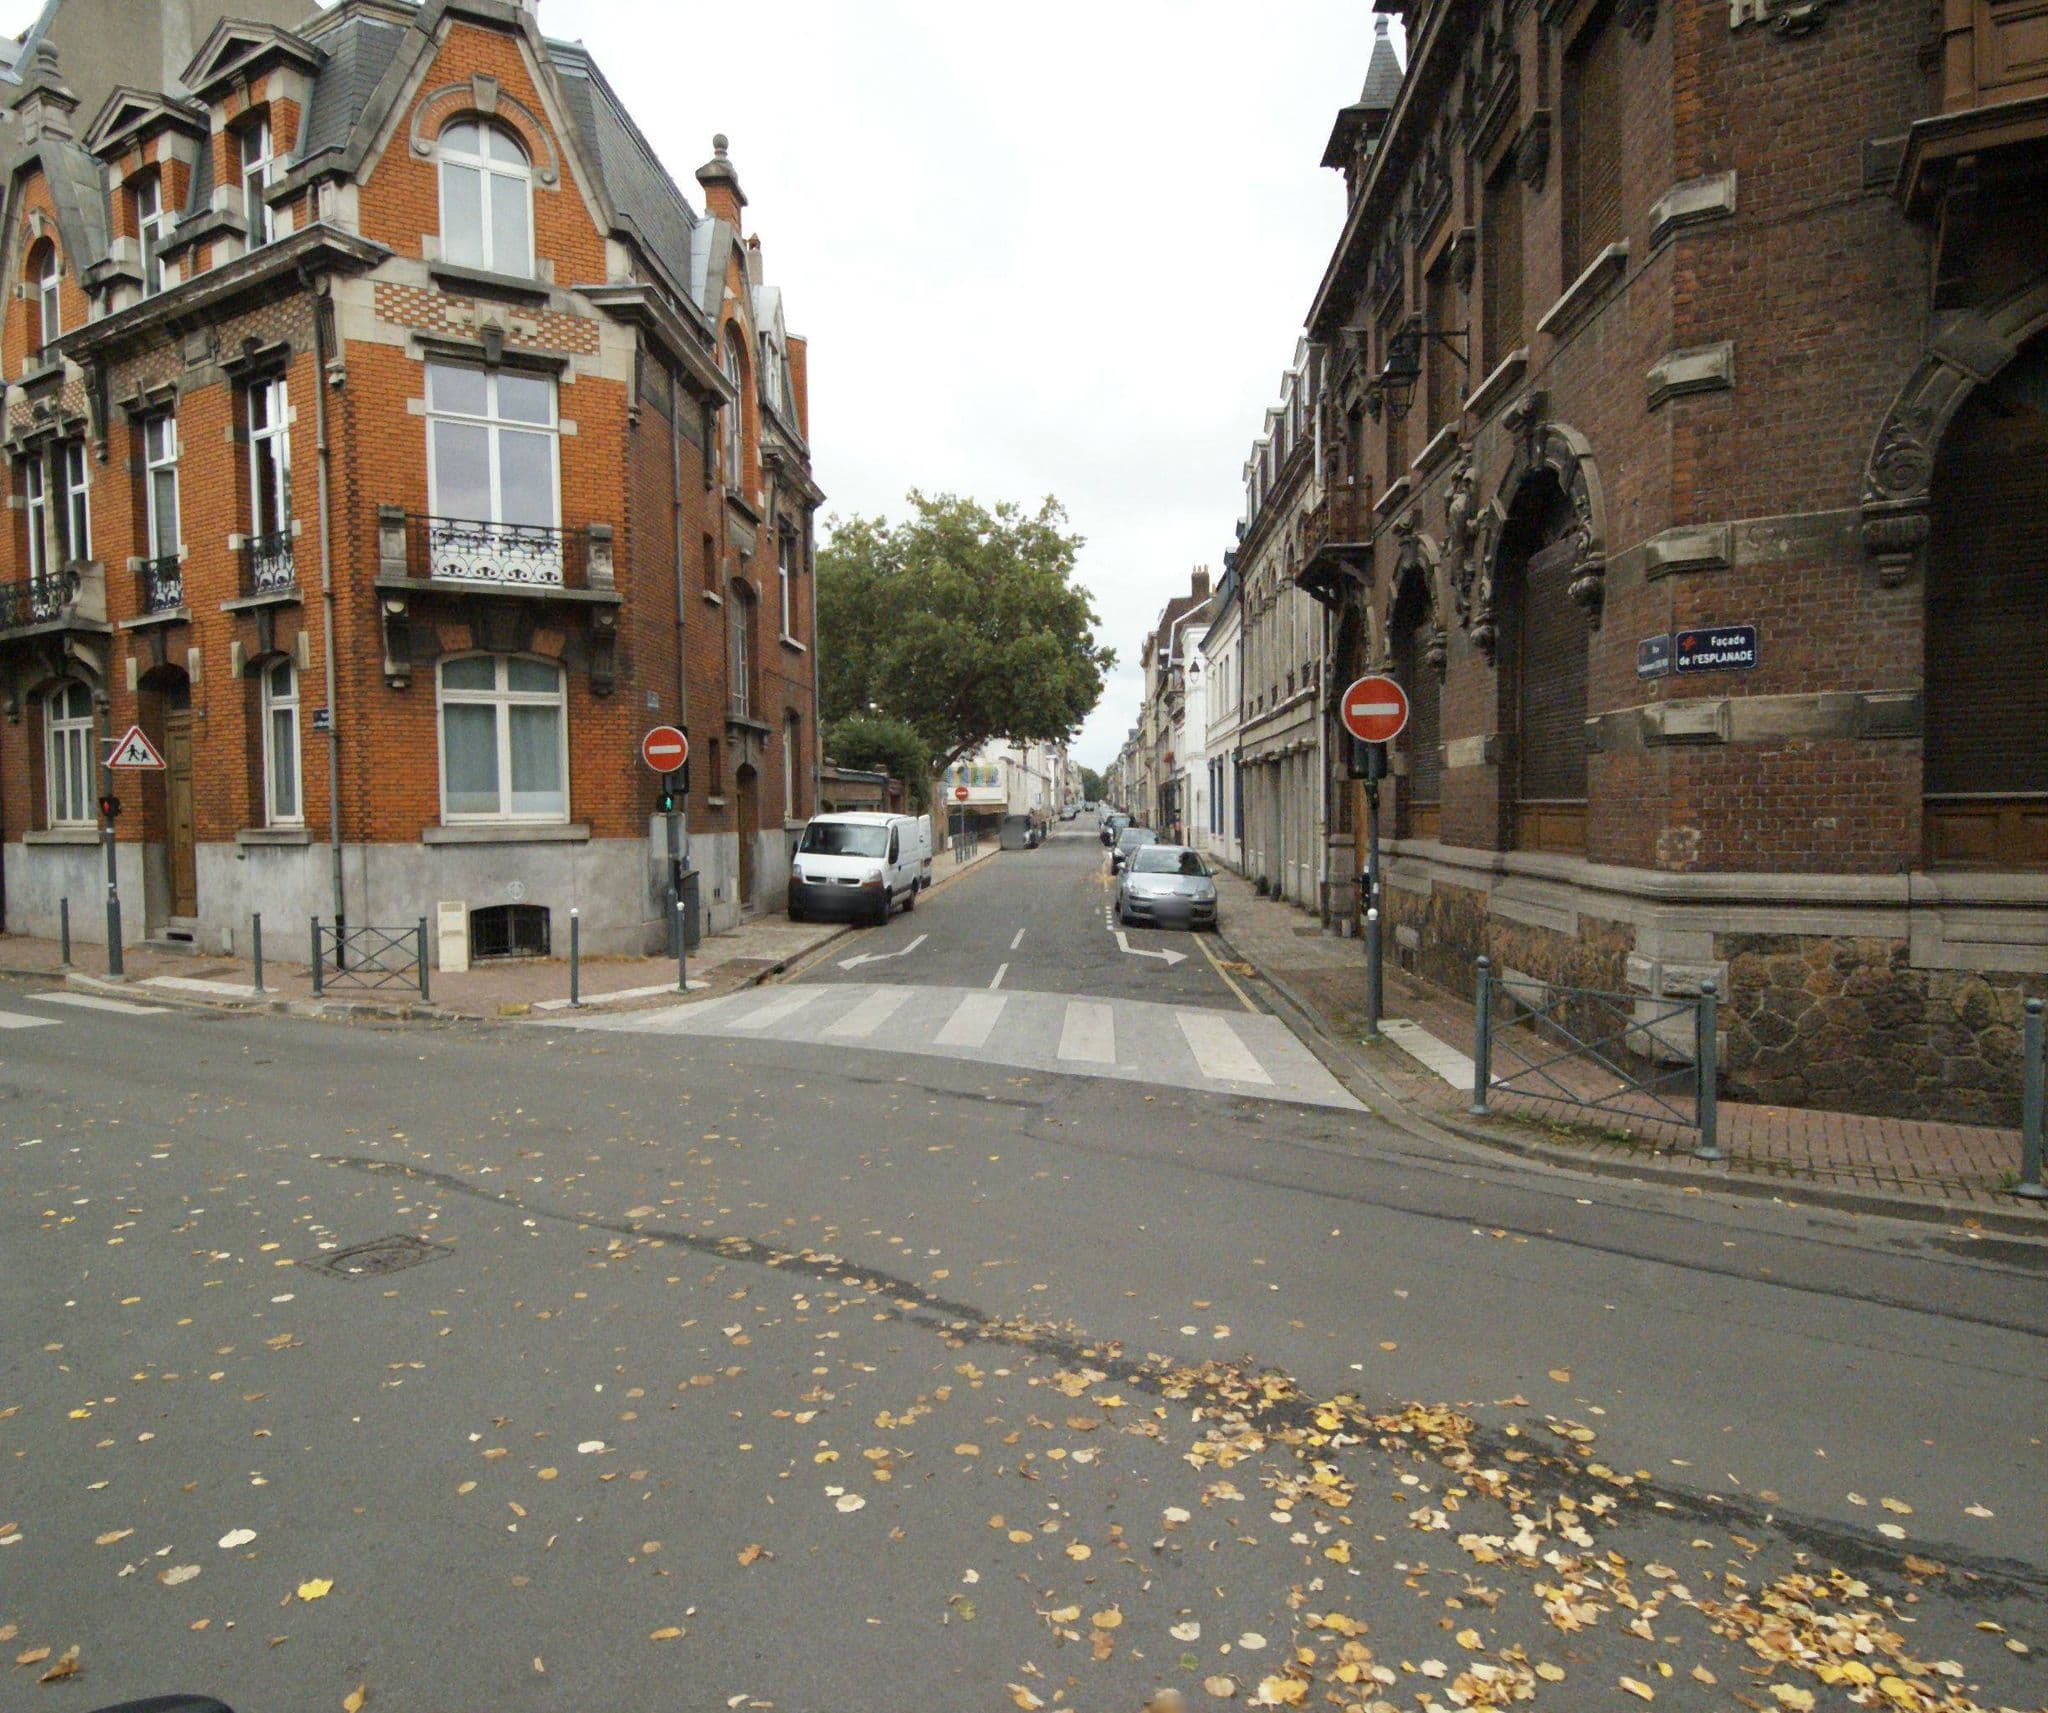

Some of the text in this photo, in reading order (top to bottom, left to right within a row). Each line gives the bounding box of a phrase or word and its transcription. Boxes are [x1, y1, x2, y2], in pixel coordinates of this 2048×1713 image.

[1711, 634, 1746, 647] Façade
[1679, 656, 1690, 666] de
[1692, 650, 1753, 664] l'ESPLANADE
